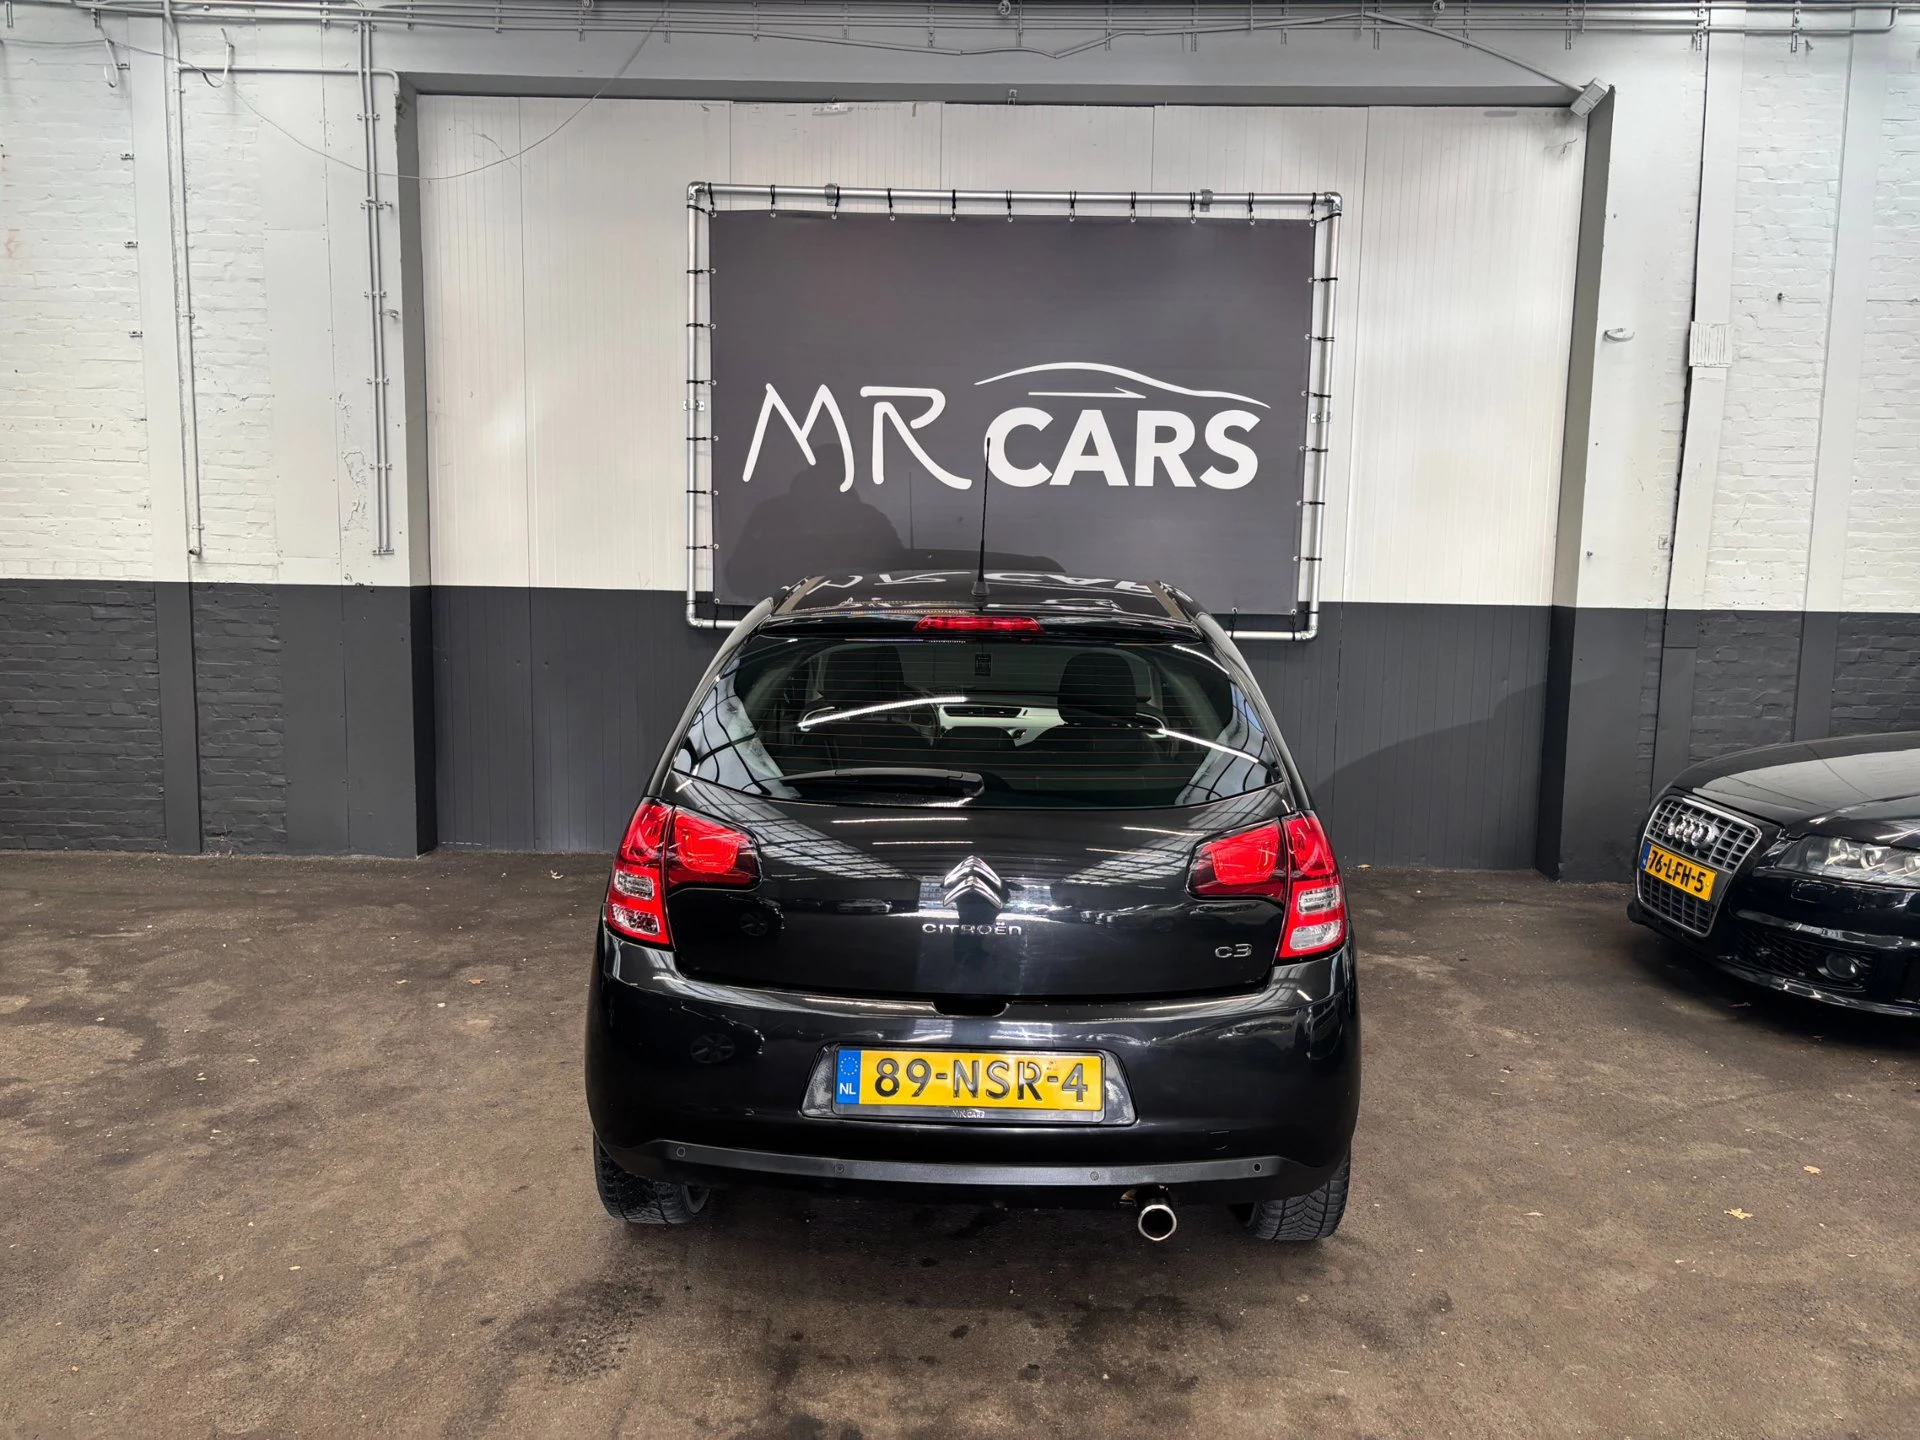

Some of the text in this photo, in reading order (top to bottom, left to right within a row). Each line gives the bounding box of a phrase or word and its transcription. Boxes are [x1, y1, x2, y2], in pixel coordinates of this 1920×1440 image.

[742, 382, 1262, 493] MR CARS
[1648, 850, 1707, 893] 76-LFH-5
[1215, 943, 1253, 958] C3
[839, 1082, 857, 1095] NL
[874, 1057, 1089, 1103] 89-NSR-4
